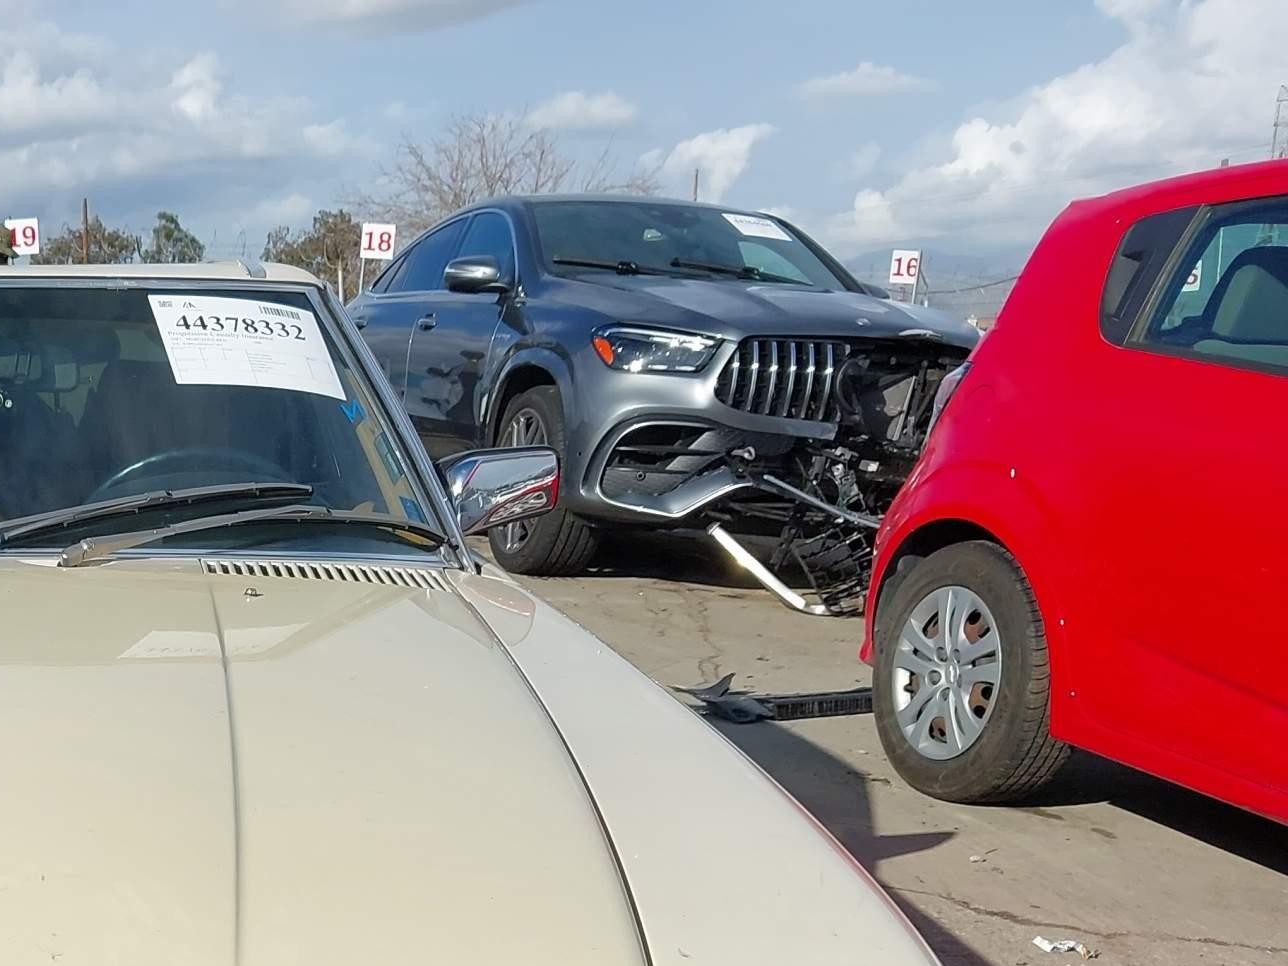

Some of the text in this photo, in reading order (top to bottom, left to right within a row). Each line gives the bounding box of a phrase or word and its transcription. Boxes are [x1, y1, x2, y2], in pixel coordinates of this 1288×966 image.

[10, 226, 36, 248] 19
[363, 231, 392, 252] 18
[892, 257, 918, 277] 16
[176, 315, 306, 341] 44378332
